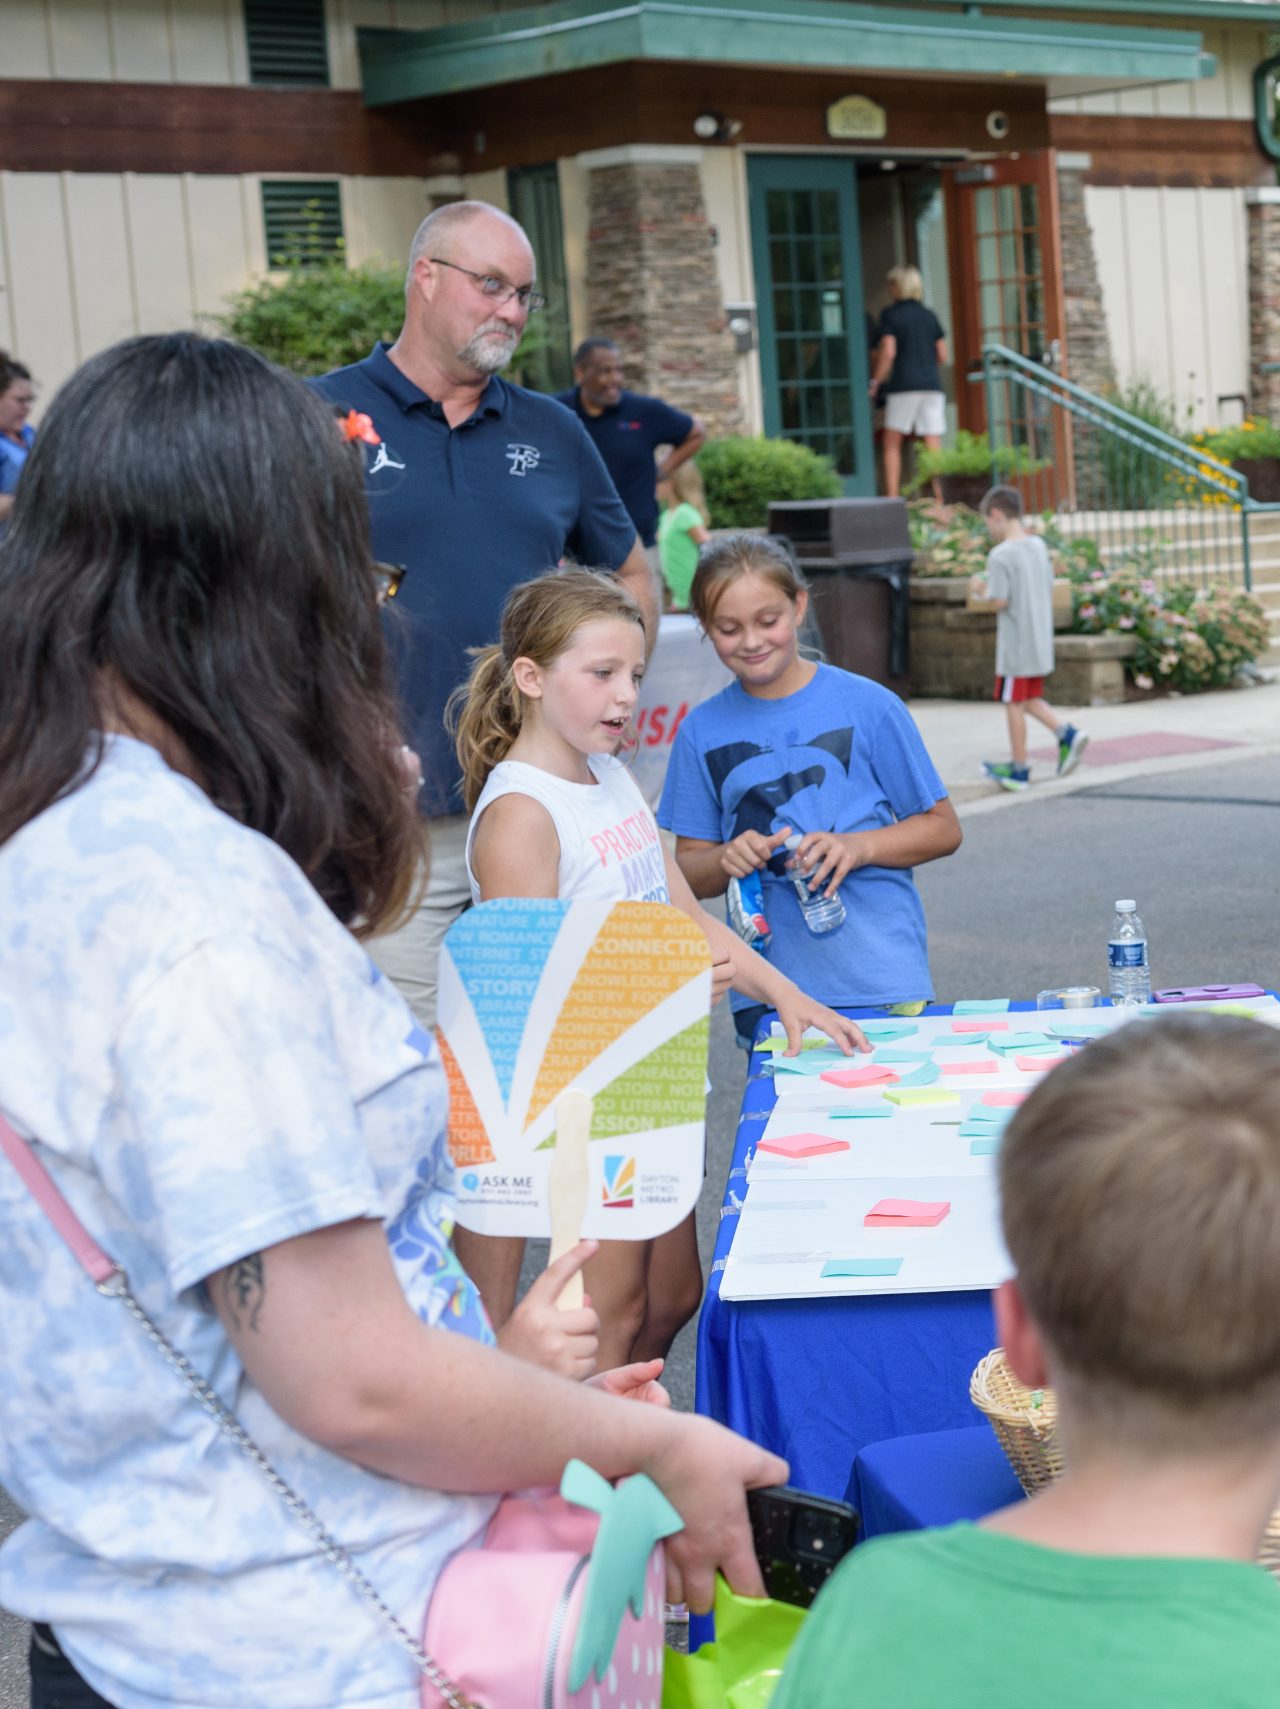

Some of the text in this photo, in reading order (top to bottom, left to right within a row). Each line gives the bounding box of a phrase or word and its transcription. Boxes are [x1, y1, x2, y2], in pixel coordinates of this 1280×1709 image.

[467, 978, 537, 995] STORY
[482, 1176, 533, 1188] ASK ME
